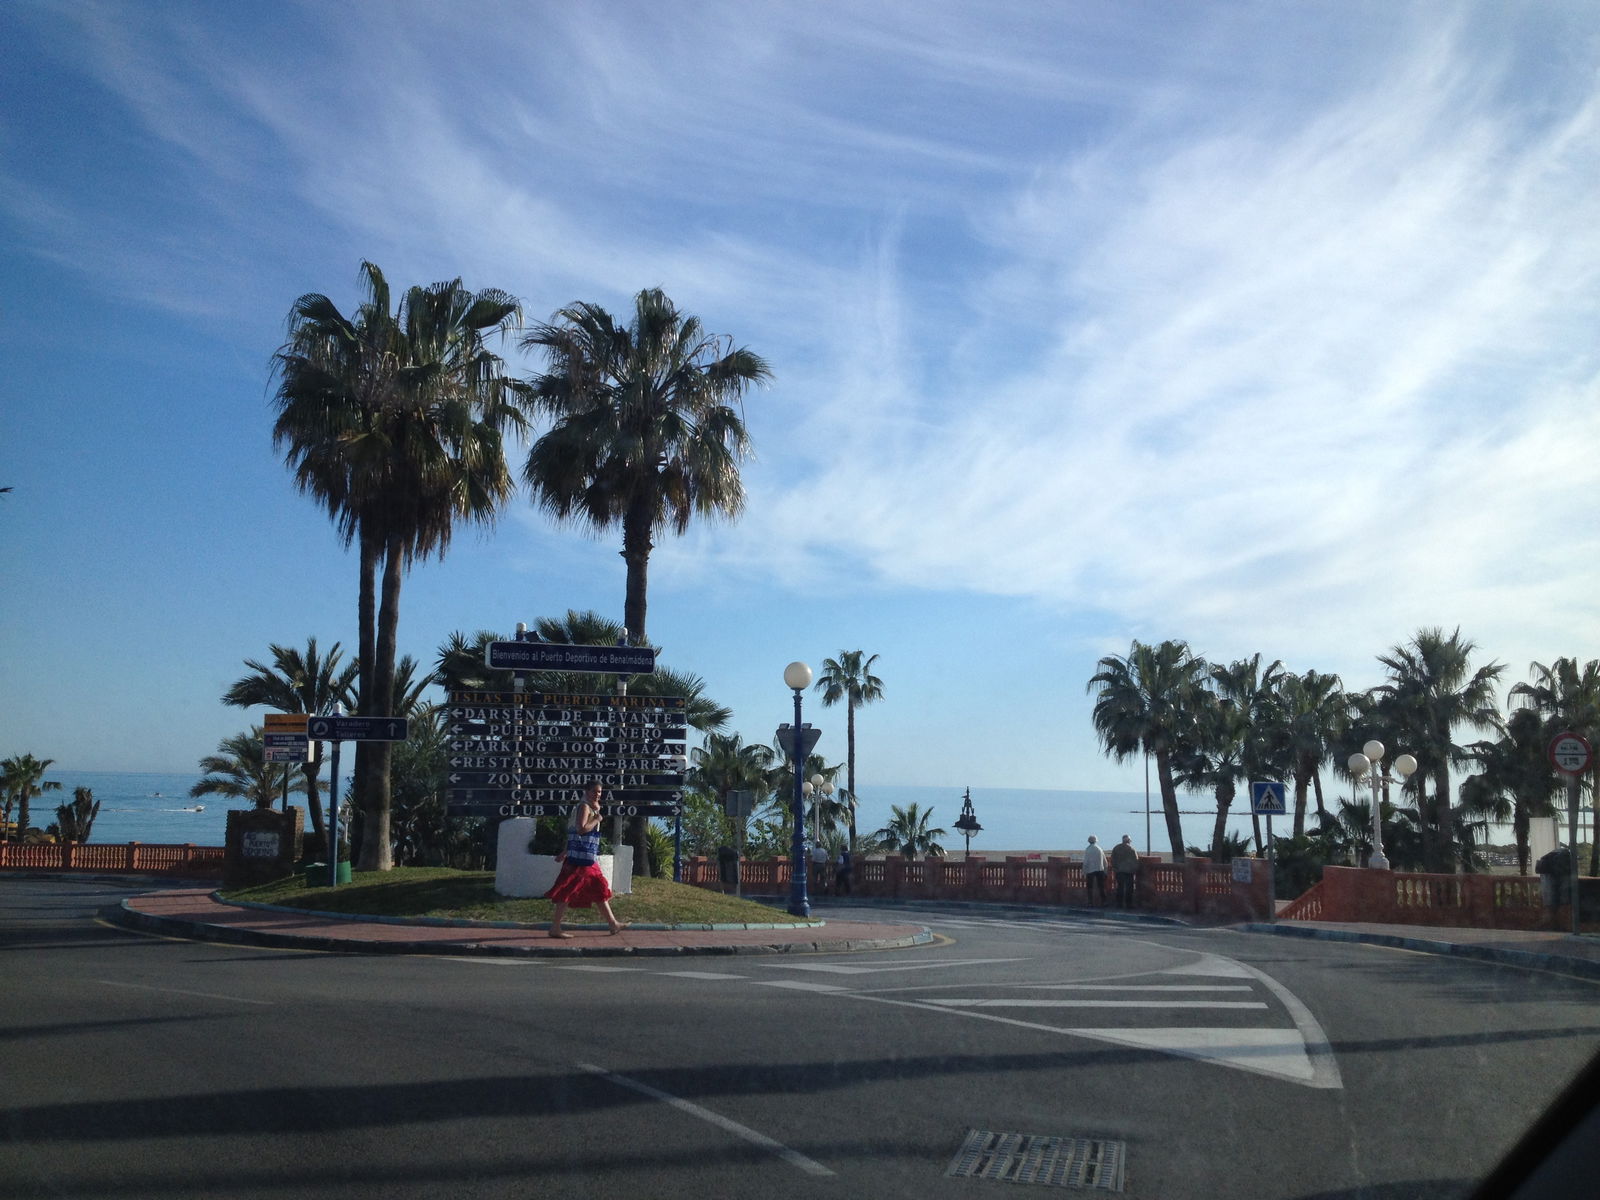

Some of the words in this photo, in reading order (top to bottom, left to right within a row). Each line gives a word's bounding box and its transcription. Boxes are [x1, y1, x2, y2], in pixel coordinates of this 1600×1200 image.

[492, 649, 530, 660] Bienvenido
[531, 651, 538, 661] al
[540, 651, 563, 662] Puerto
[565, 652, 598, 665] Deportivo
[599, 653, 608, 664] de
[454, 692, 502, 703] ISLAS
[513, 694, 531, 704] DE
[543, 694, 601, 706] PUERTO
[610, 696, 667, 708] MARINA
[464, 707, 548, 721] DARSENA
[561, 710, 582, 722] DE
[596, 711, 673, 724] LEVANTE
[489, 724, 560, 737] PUEBLO
[571, 726, 663, 739] MARINERO
[464, 740, 548, 753] PARKING
[562, 742, 606, 753] 1000
[618, 743, 684, 756] PLAZAS
[463, 757, 604, 770] RESTAURANTES
[617, 758, 672, 771] BARES
[487, 772, 534, 785] ZONA
[547, 773, 650, 786] COMERCIAL
[511, 789, 615, 801] CAPITAA
[499, 804, 546, 817] CLUB
